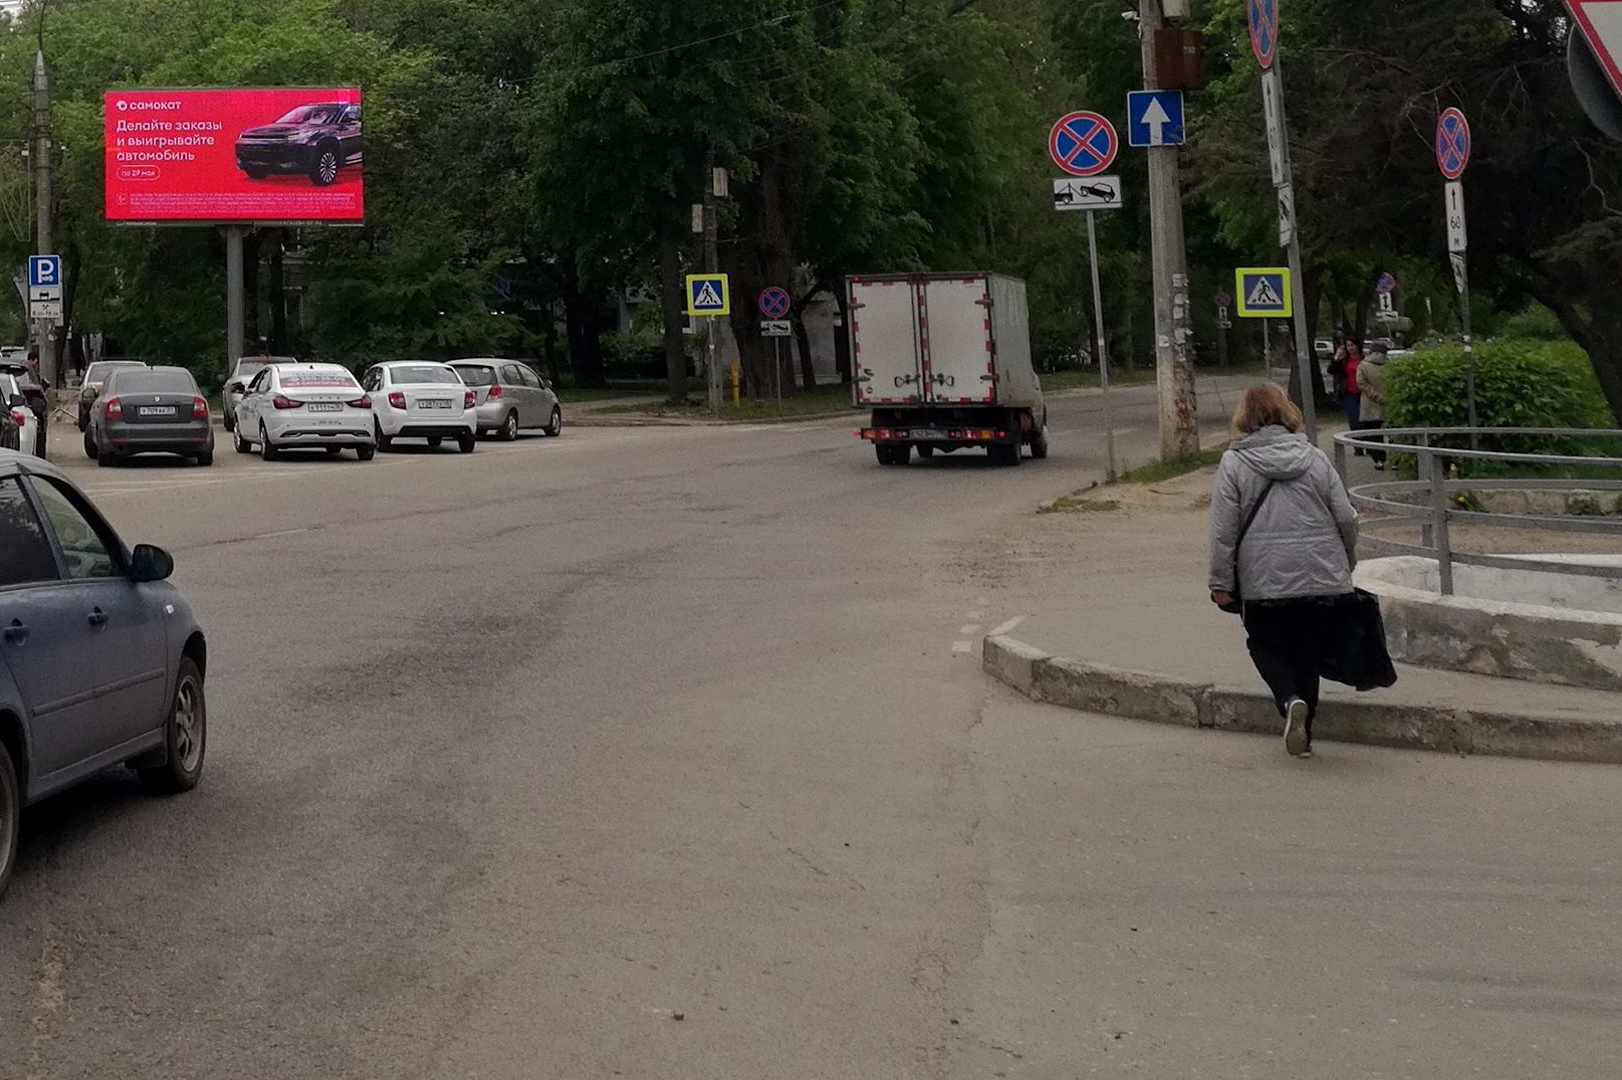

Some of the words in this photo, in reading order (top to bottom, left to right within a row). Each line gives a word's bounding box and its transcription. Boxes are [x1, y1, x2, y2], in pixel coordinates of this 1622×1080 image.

[129, 101, 182, 111] самокат
[116, 119, 173, 132] Делайте
[175, 121, 223, 131] заказы
[116, 137, 125, 147] и
[127, 133, 215, 148] выигрывайте
[116, 149, 196, 161] автомобиль
[1450, 215, 1461, 230] 60
